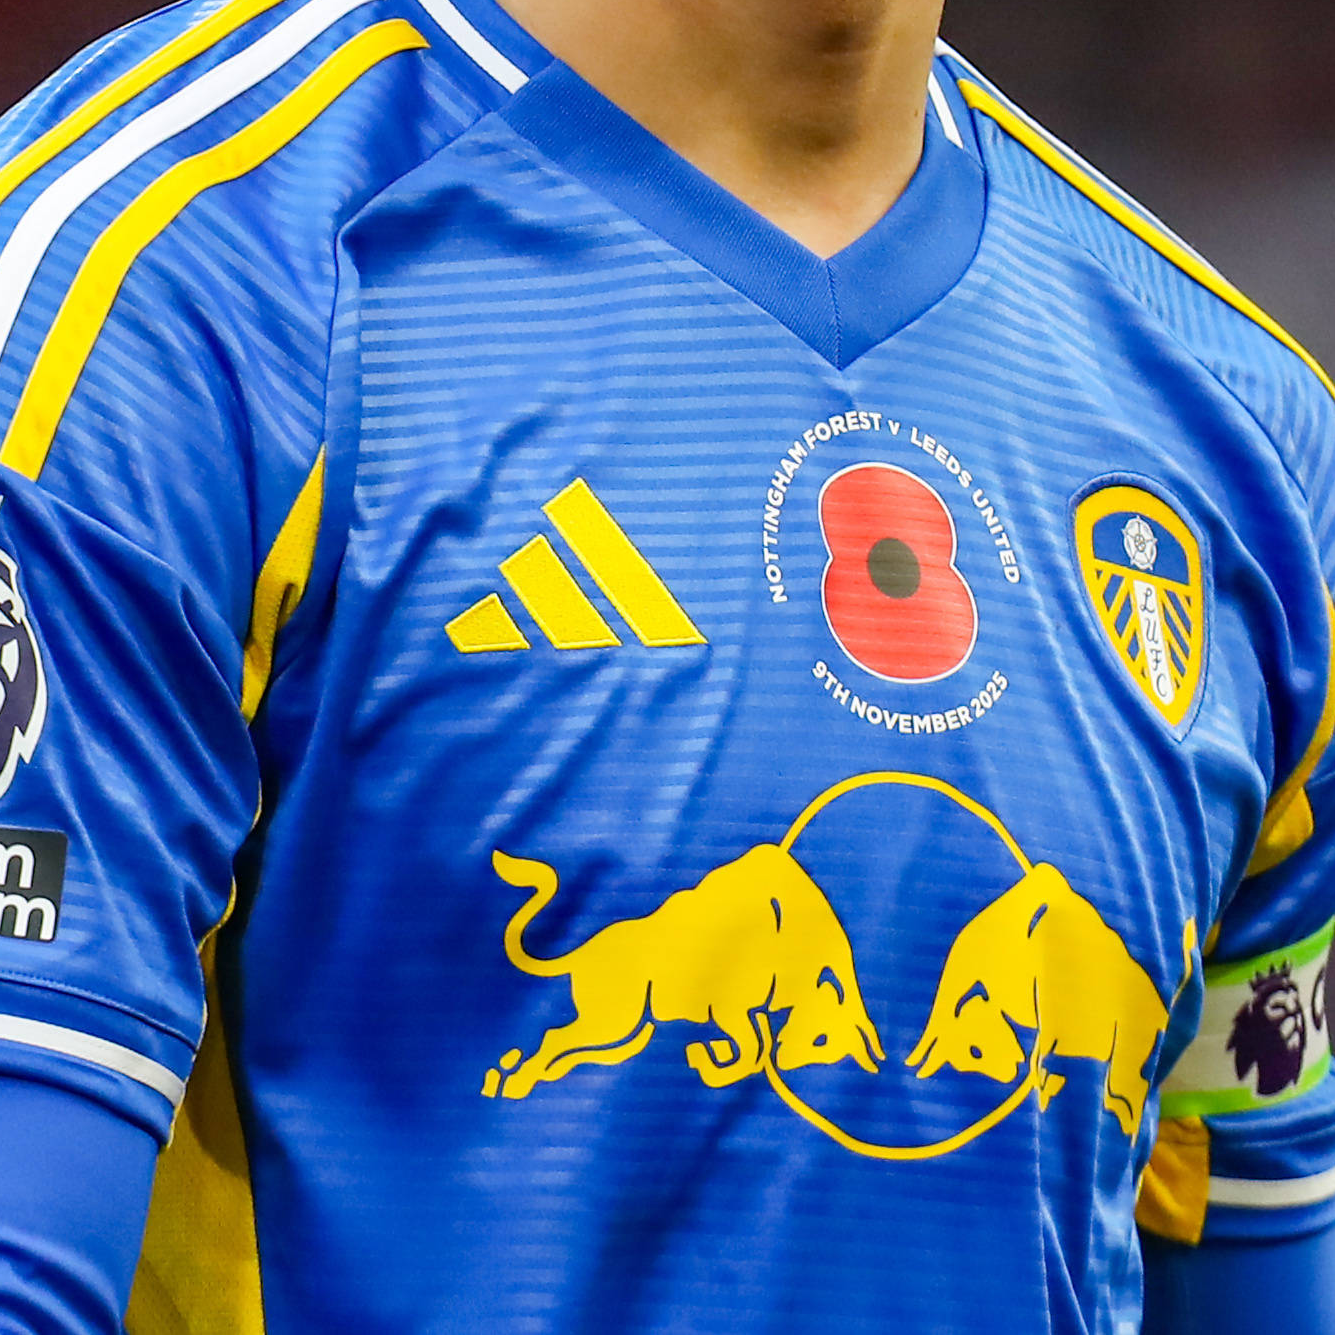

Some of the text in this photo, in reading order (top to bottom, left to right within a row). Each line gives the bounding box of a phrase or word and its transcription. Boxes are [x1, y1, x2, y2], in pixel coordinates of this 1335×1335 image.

[763, 440, 809, 604] NOTTINGHAM
[802, 411, 883, 451] FOREST
[910, 426, 974, 489] LEEDS
[971, 489, 1021, 585] UNITED
[811, 660, 1009, 734] 9TH NOVEMBER 2025
